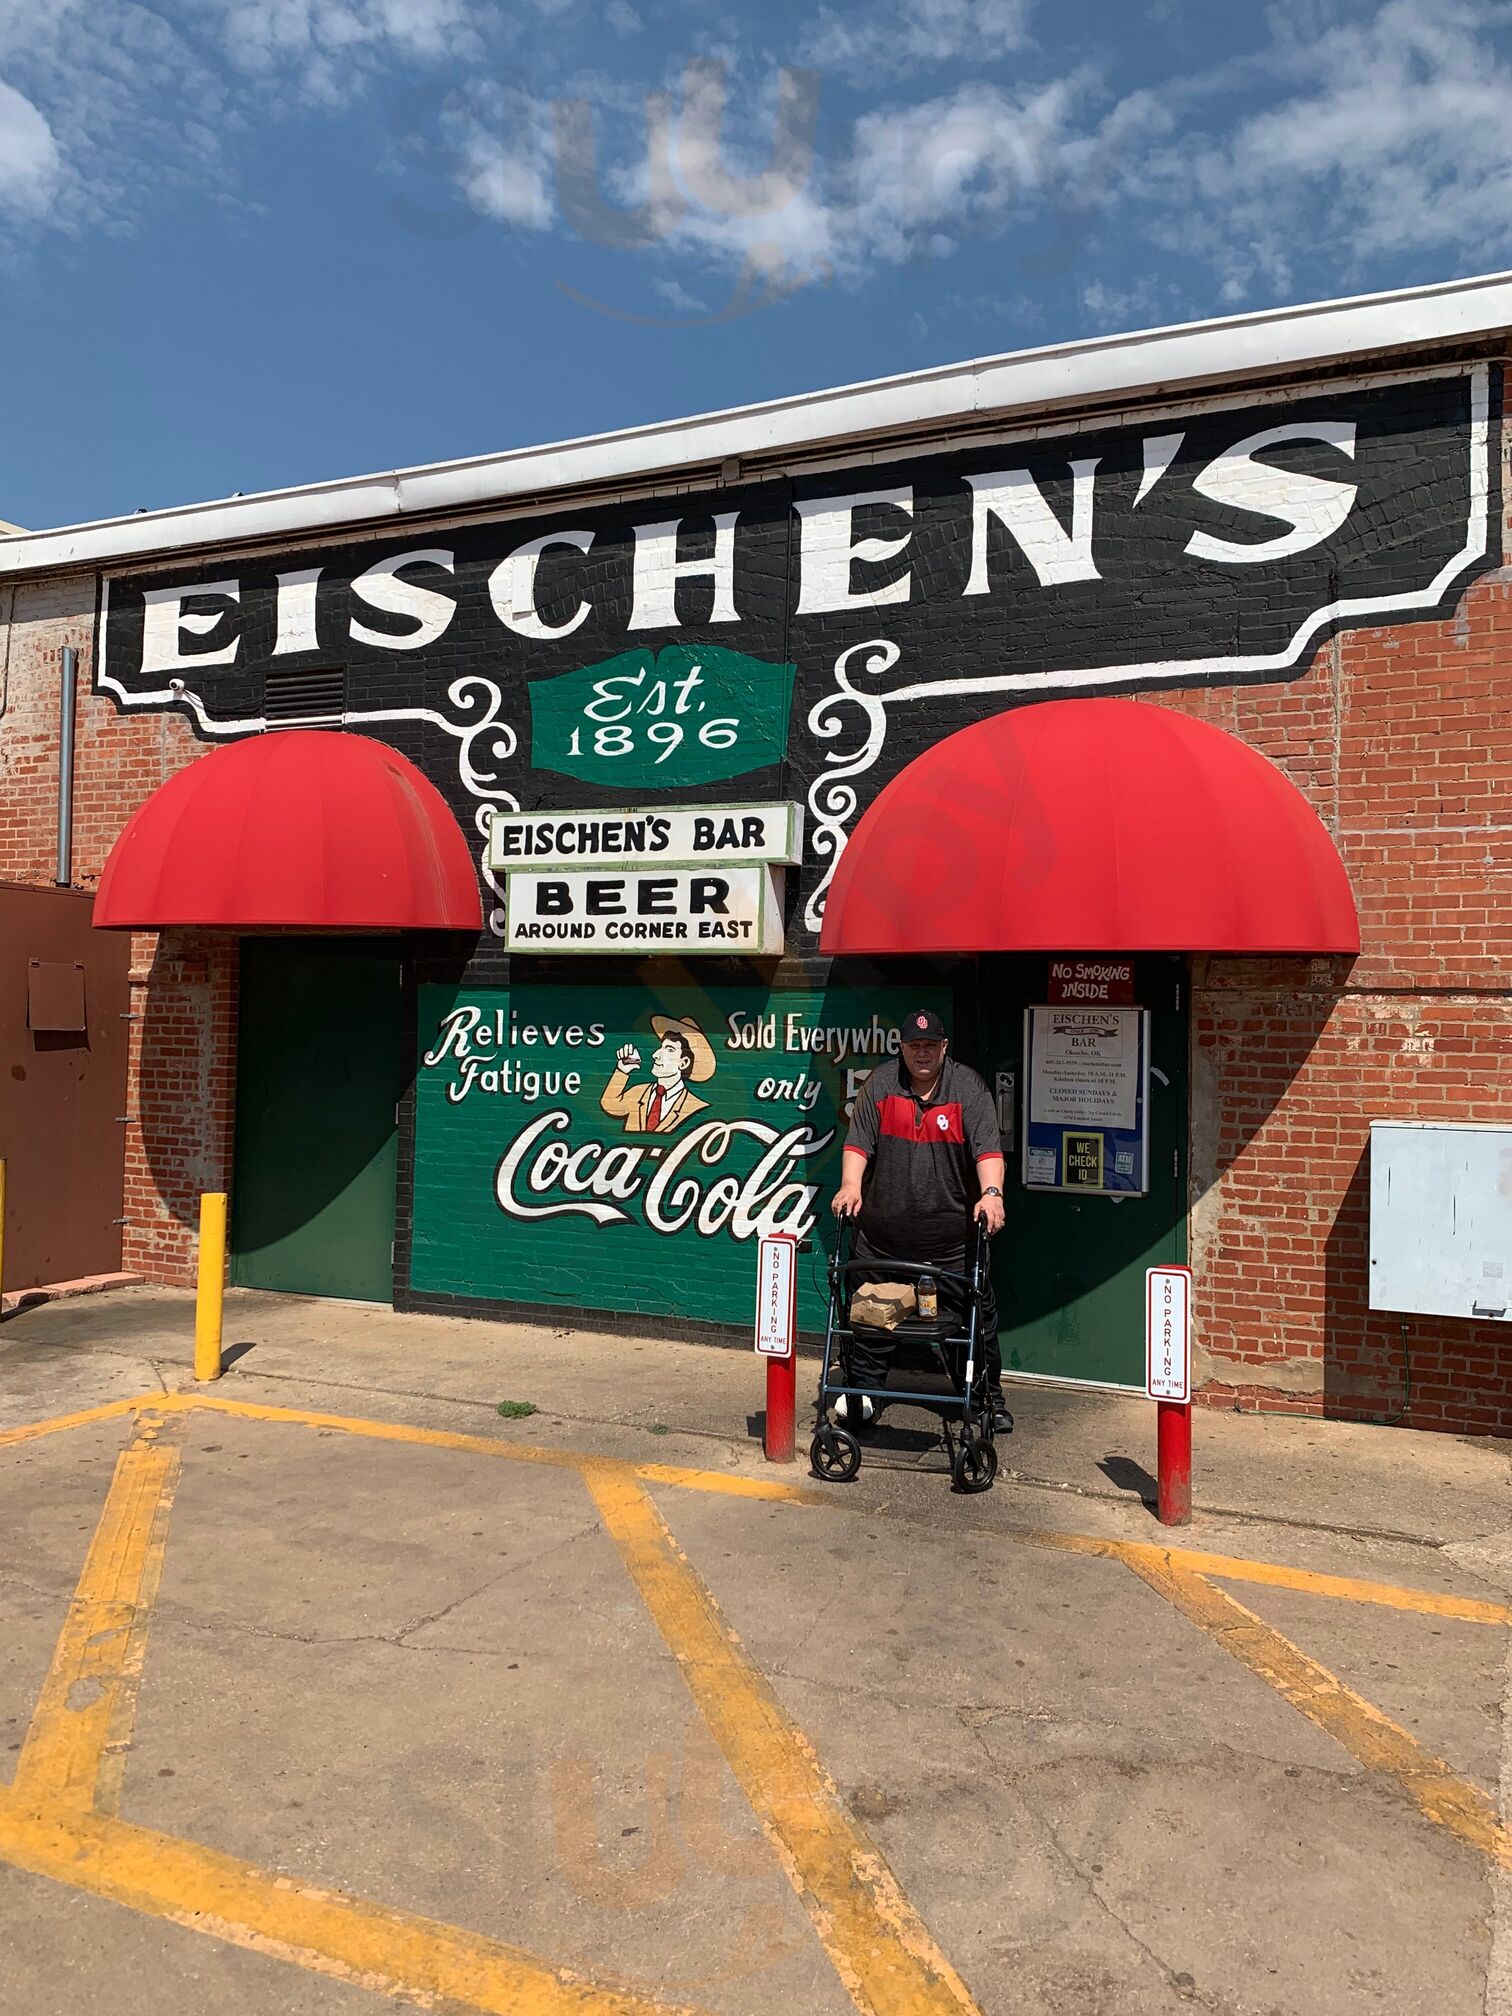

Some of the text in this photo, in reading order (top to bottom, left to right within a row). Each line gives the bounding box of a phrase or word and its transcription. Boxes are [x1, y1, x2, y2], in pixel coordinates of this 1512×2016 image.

[140, 422, 1358, 673] EISCHEN'S
[584, 666, 705, 722] Est.
[566, 718, 740, 763] 1896
[503, 814, 766, 856] EISCHEN'S BAR
[535, 877, 730, 916] BEER
[515, 920, 752, 939] AROUND CORNER EAST
[1061, 982, 1109, 999] INSIDE
[727, 1011, 776, 1049] Sold
[1052, 1014, 1120, 1026] EISCHEN'S
[424, 1006, 605, 1066] Relieves
[1071, 1037, 1097, 1047] BAR
[450, 1051, 581, 1101] Fatigue
[757, 1073, 822, 1111] only
[1078, 1096, 1115, 1104] HOLIDAYS
[1068, 1154, 1097, 1167] CHECK
[1076, 1142, 1090, 1154] WE
[496, 1111, 835, 1240] Coca-Cola
[1078, 1168, 1088, 1180] ID
[773, 1252, 780, 1269] NO
[770, 1273, 779, 1333] PARKING
[1164, 1285, 1172, 1304] NO
[760, 1335, 786, 1345] ANY TIME
[1164, 1309, 1172, 1376] PARKING
[1152, 1379, 1183, 1389] ANY TIME
